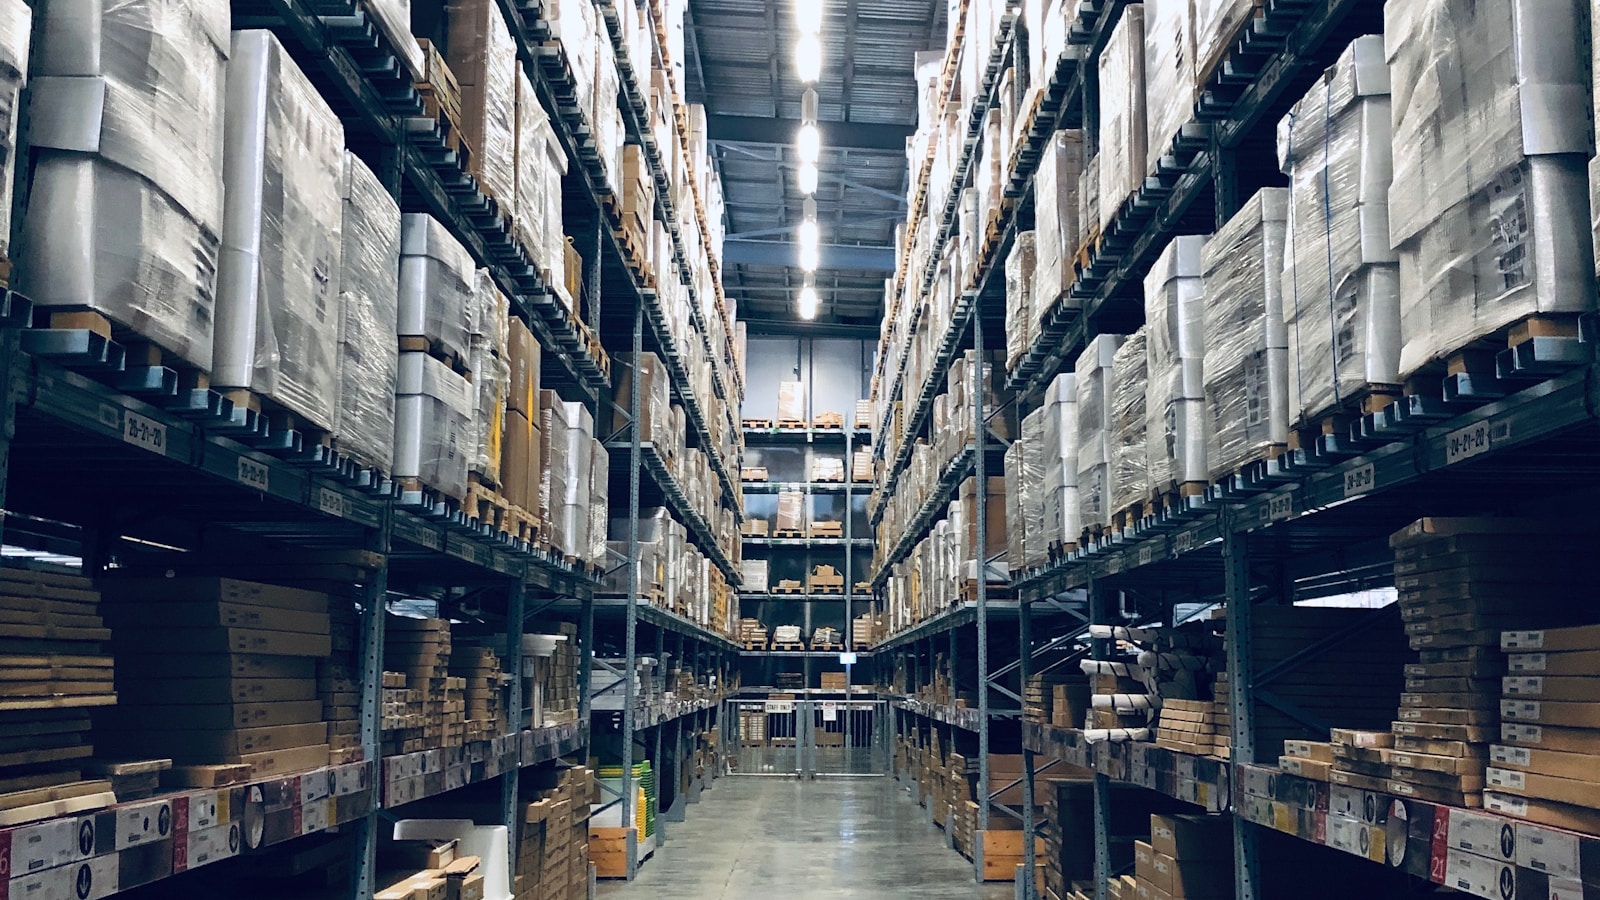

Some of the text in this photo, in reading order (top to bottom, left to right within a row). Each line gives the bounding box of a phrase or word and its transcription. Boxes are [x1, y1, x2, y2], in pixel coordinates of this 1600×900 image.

[1450, 427, 1485, 456] 24-21-20
[1433, 818, 1446, 840] 24
[1431, 856, 1444, 879] 21
